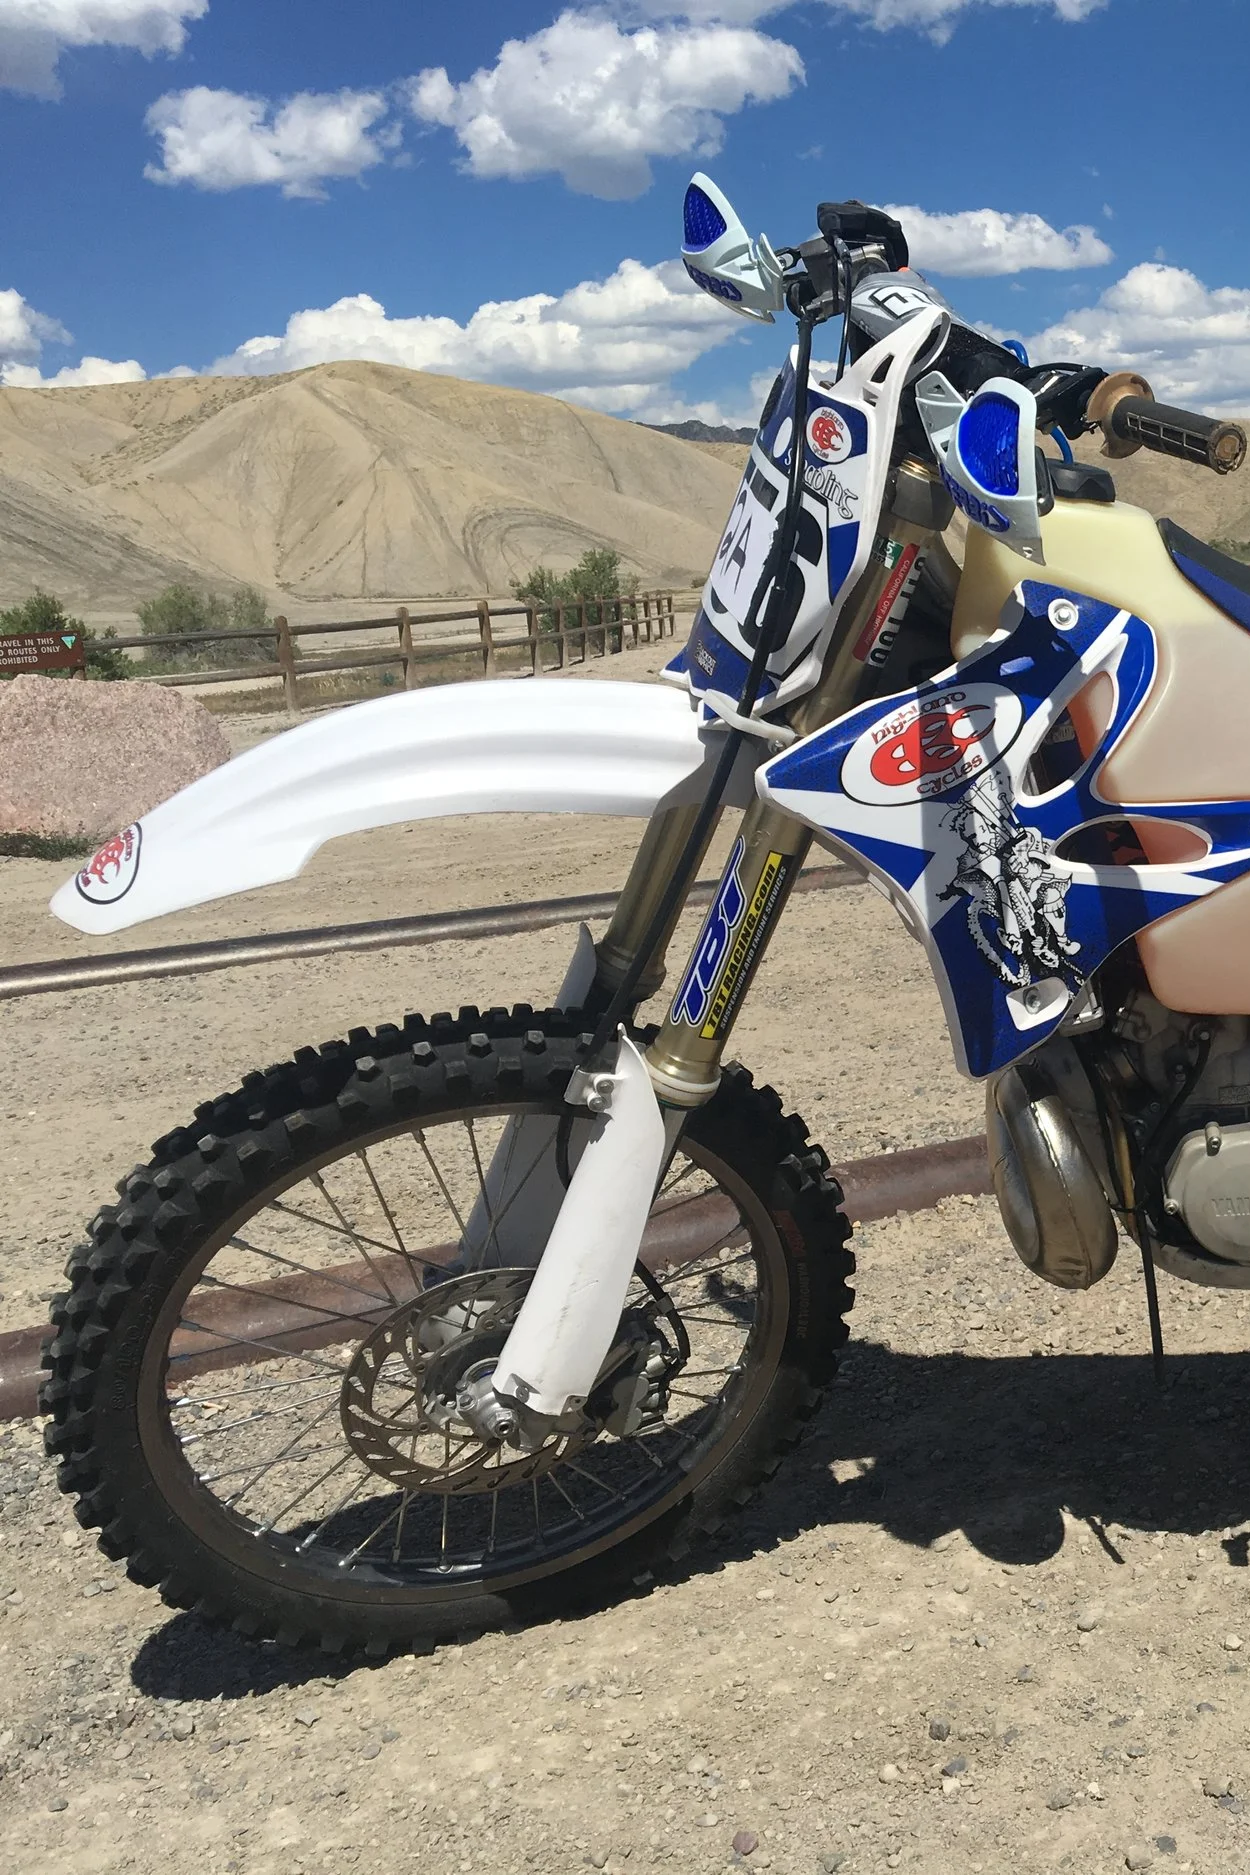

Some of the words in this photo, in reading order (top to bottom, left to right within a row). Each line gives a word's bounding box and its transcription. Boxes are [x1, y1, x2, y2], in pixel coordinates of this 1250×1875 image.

[784, 447, 859, 520] sadling
[8, 647, 37, 656] ROUTES
[41, 645, 60, 654] ONLY
[25, 638, 34, 646] IN
[37, 637, 54, 645] THIS
[916, 754, 983, 794] cycles
[718, 969, 748, 1030] SUSPENSION
[742, 948, 756, 971] AND
[751, 913, 770, 949] ENGINE
[764, 865, 788, 915] SERVICES
